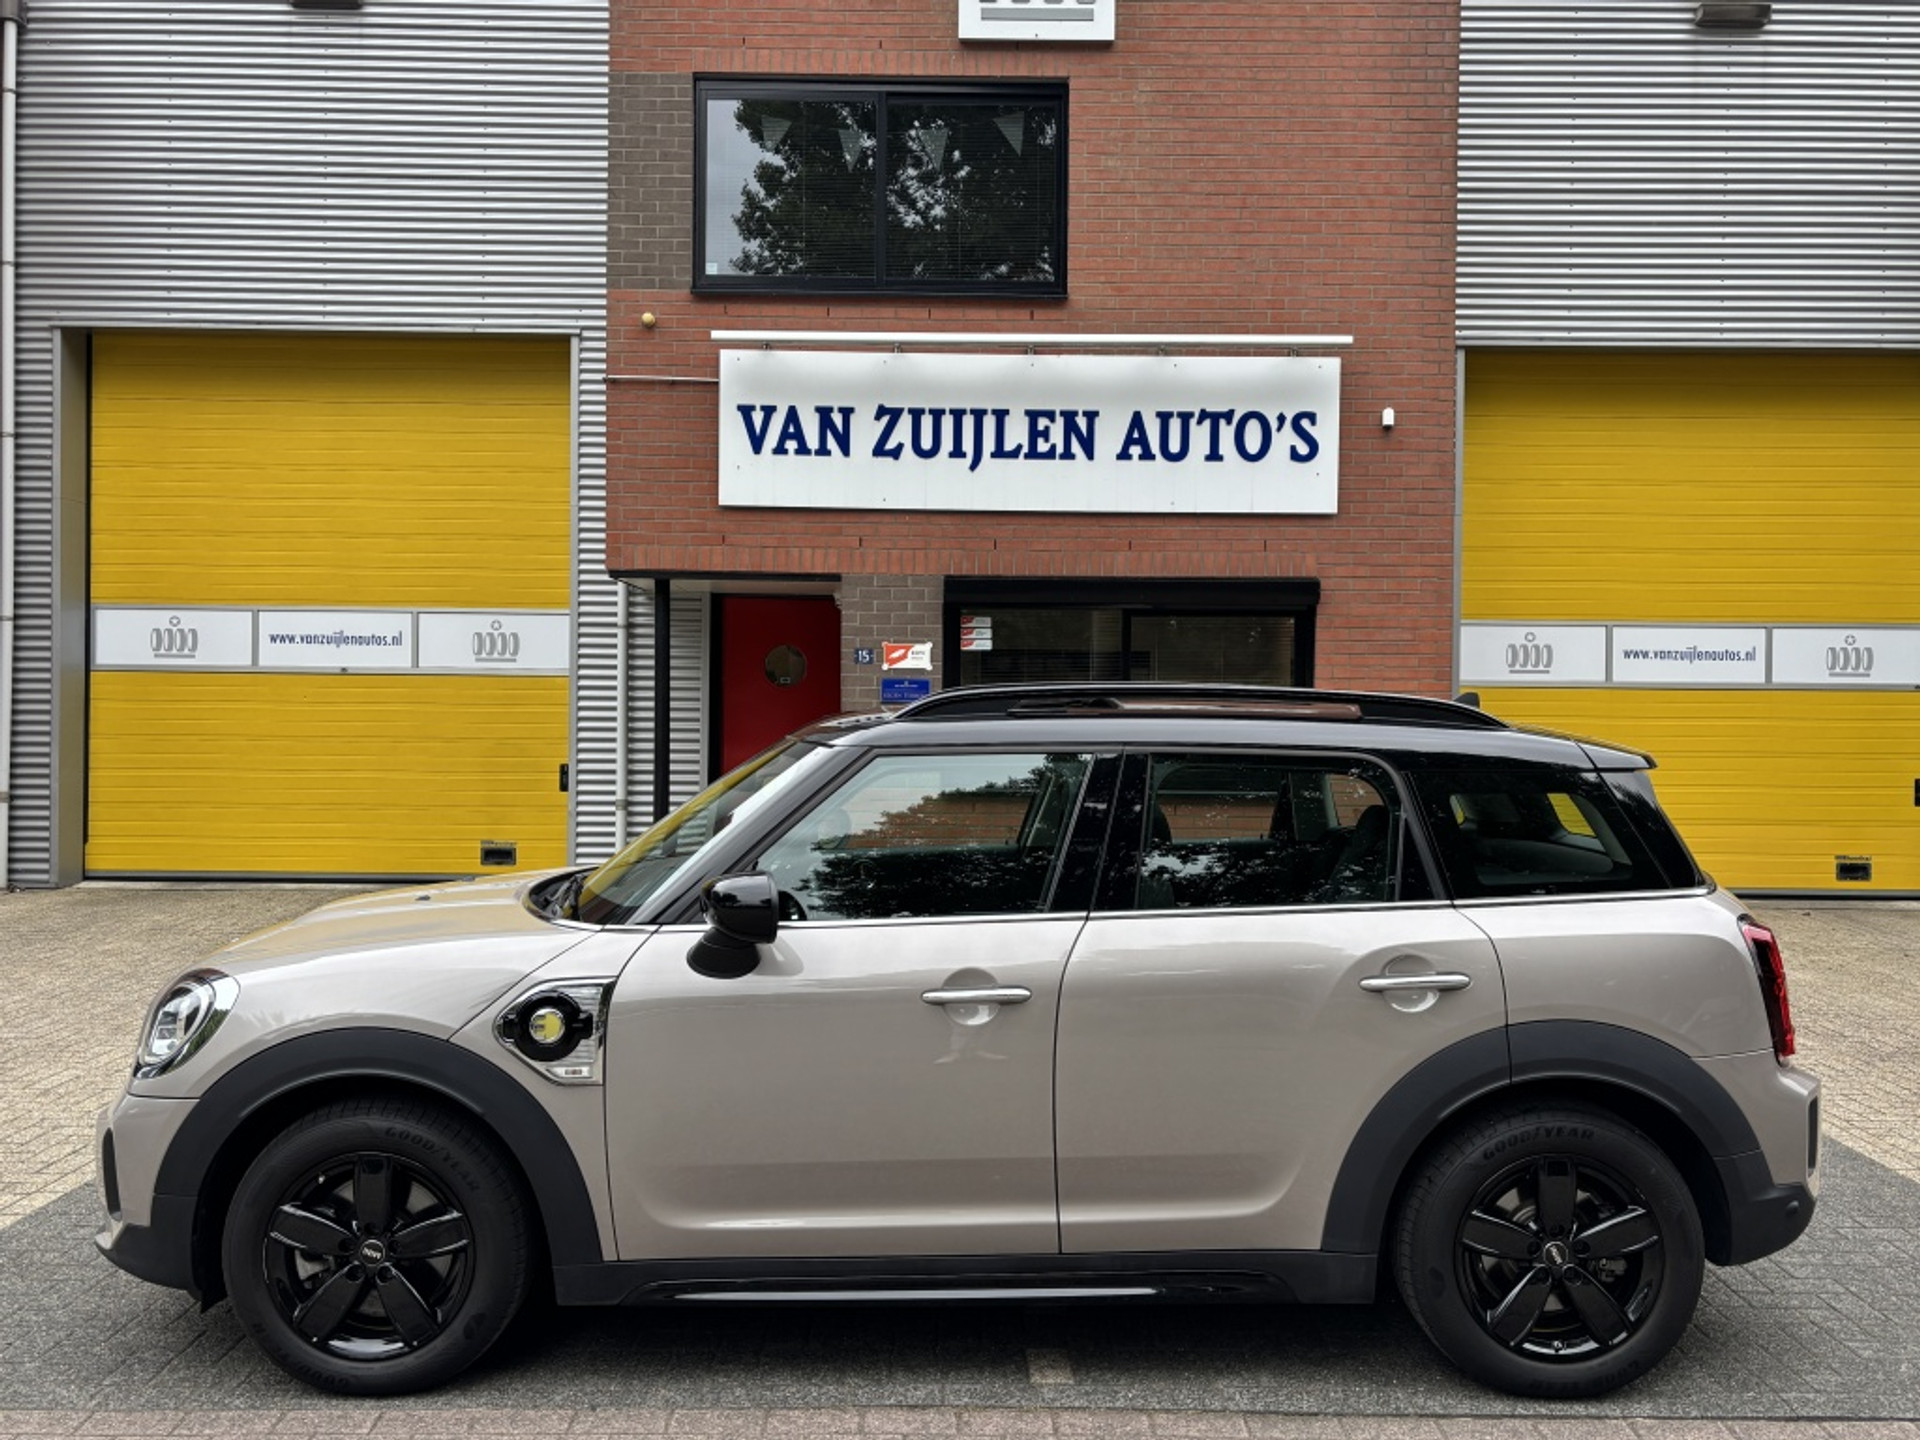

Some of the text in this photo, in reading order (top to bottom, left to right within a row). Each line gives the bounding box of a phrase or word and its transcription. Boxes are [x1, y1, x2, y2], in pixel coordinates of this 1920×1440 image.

[737, 404, 1320, 472] VAN ZUIJLEN AUTO'S
[268, 630, 403, 648] www.vanzuijlenautos.nl
[858, 650, 870, 662] 15
[1622, 645, 1757, 663] www.vanzuijlenautos.nl
[1483, 1126, 1595, 1160] GOODYEAR
